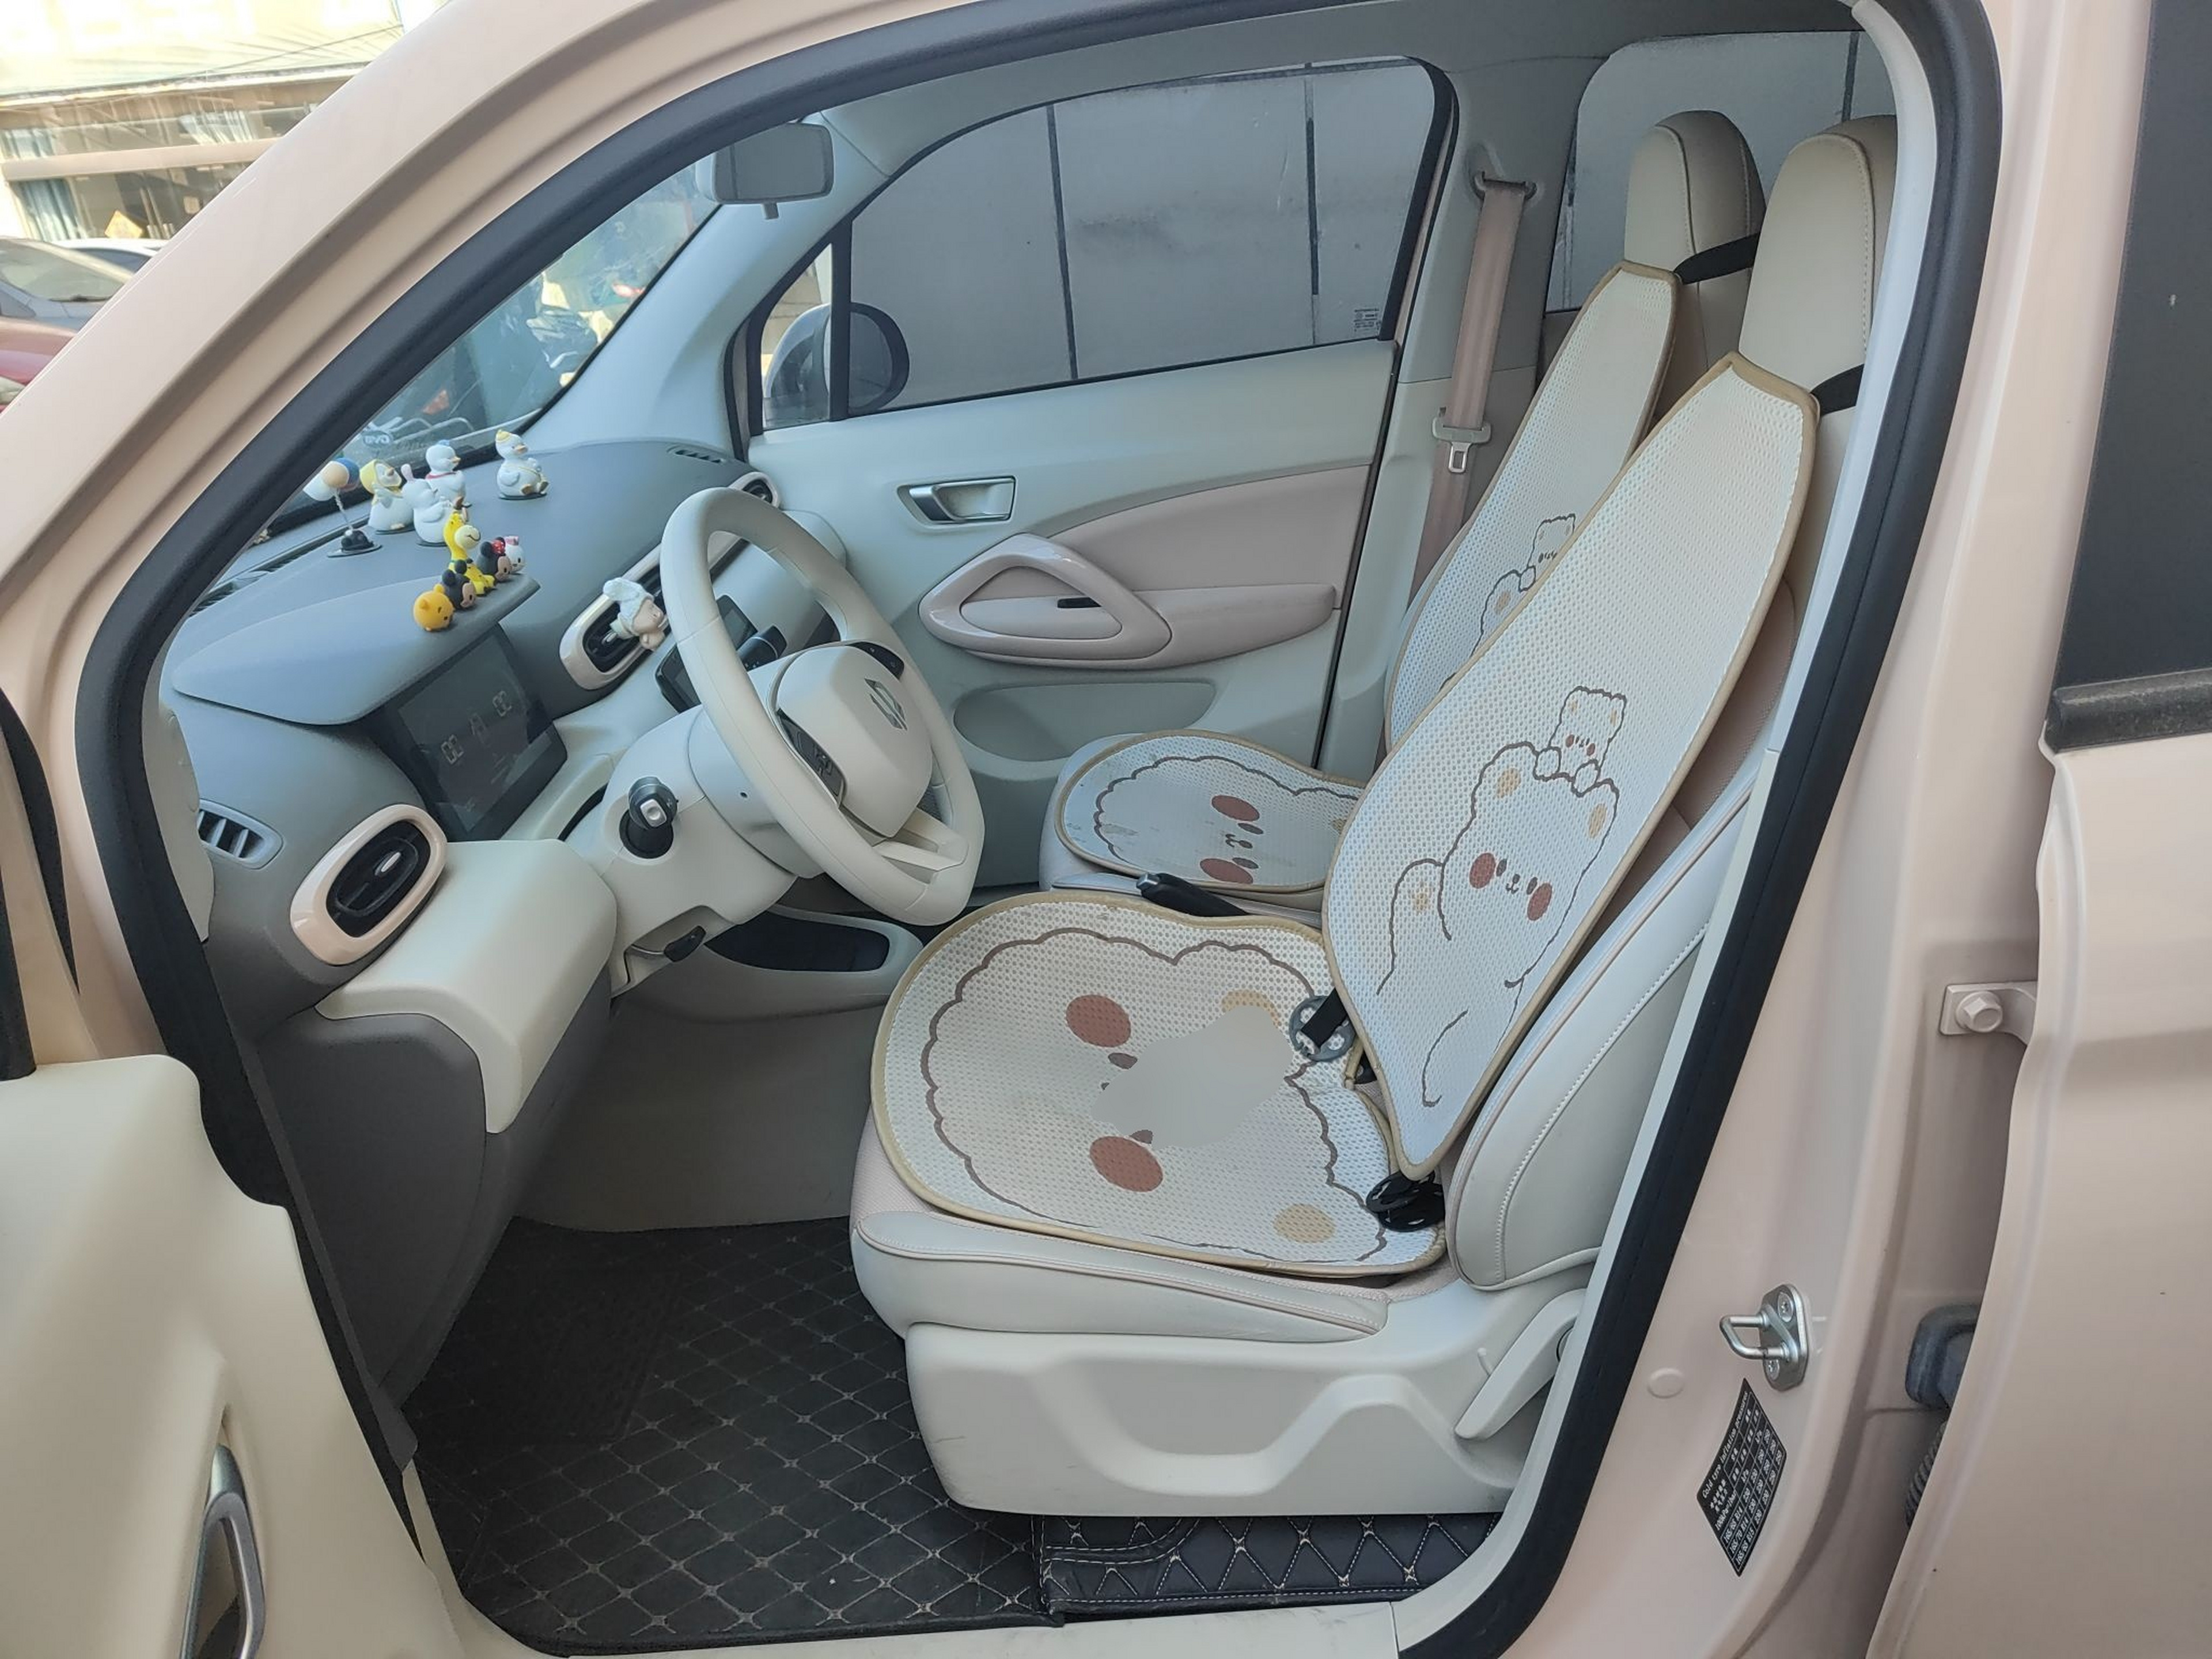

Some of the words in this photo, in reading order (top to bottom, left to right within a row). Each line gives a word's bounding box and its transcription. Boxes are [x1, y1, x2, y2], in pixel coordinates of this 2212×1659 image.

[1702, 1479, 1713, 1498] Cold
[1711, 1464, 1721, 1480] tyre
[1719, 1428, 1736, 1463] inflation
